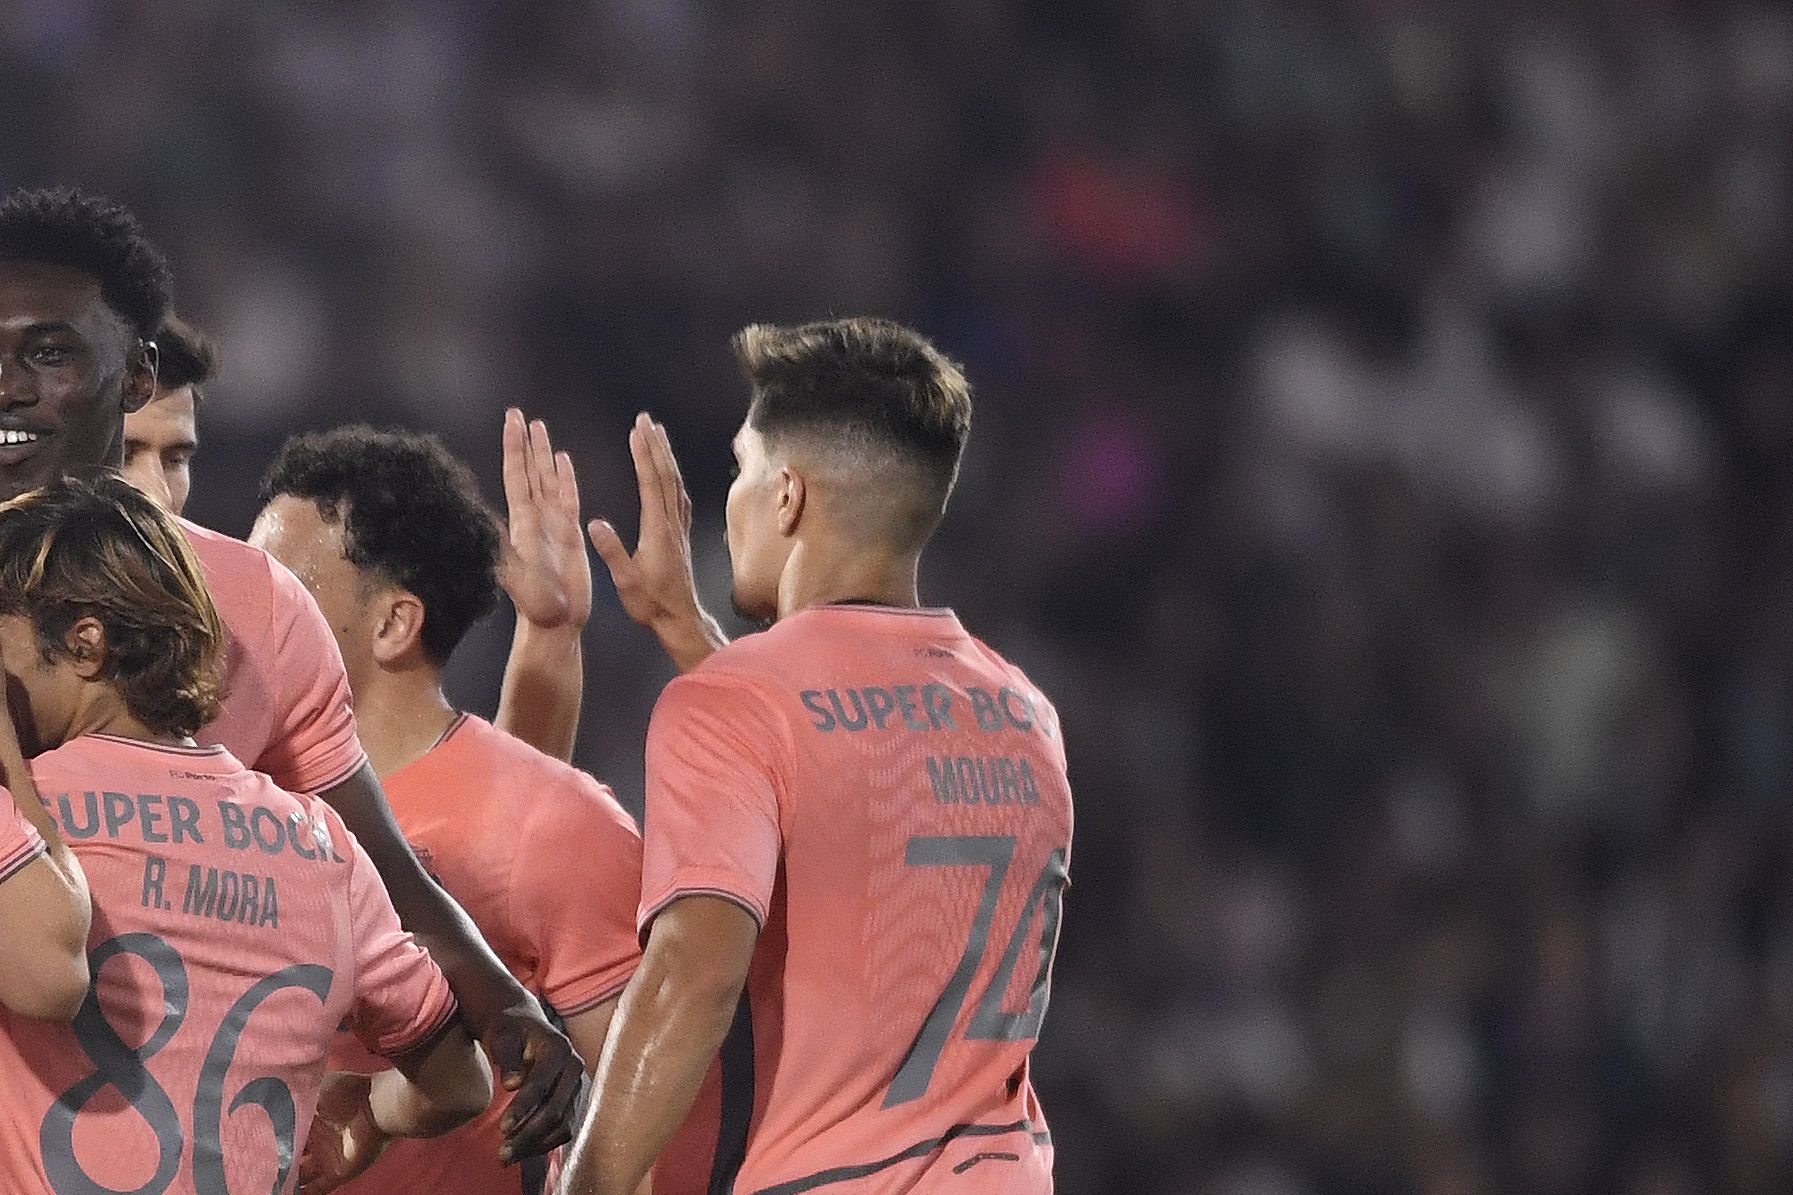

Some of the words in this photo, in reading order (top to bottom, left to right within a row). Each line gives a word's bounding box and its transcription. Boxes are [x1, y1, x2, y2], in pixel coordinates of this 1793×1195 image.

[801, 682, 958, 733] SUPER
[927, 756, 1040, 806] MOURA
[142, 856, 171, 910] R.
[183, 864, 278, 928] MORA
[880, 836, 1067, 1110] 74
